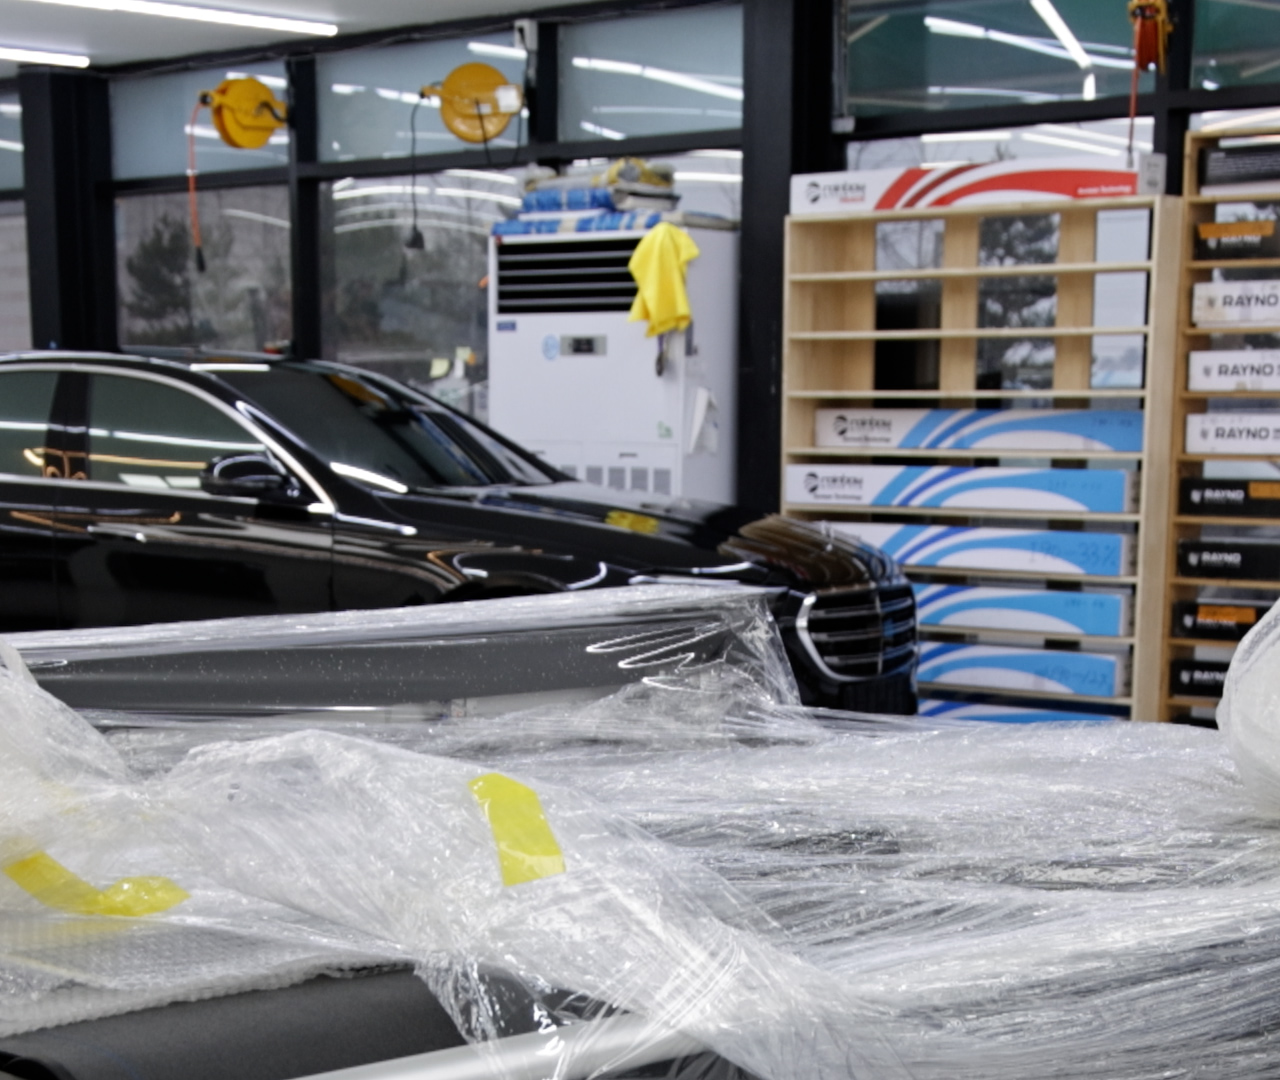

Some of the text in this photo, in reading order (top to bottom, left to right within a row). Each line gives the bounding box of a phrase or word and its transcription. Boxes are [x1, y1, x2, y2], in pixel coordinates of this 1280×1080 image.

[1222, 293, 1279, 307] RAYNO
[1217, 363, 1275, 376] RAYNO
[1214, 426, 1270, 439] RAYNO
[1203, 488, 1245, 500] RAYNO
[1200, 551, 1242, 562] RAYNO
[1193, 670, 1227, 681] RAYN
